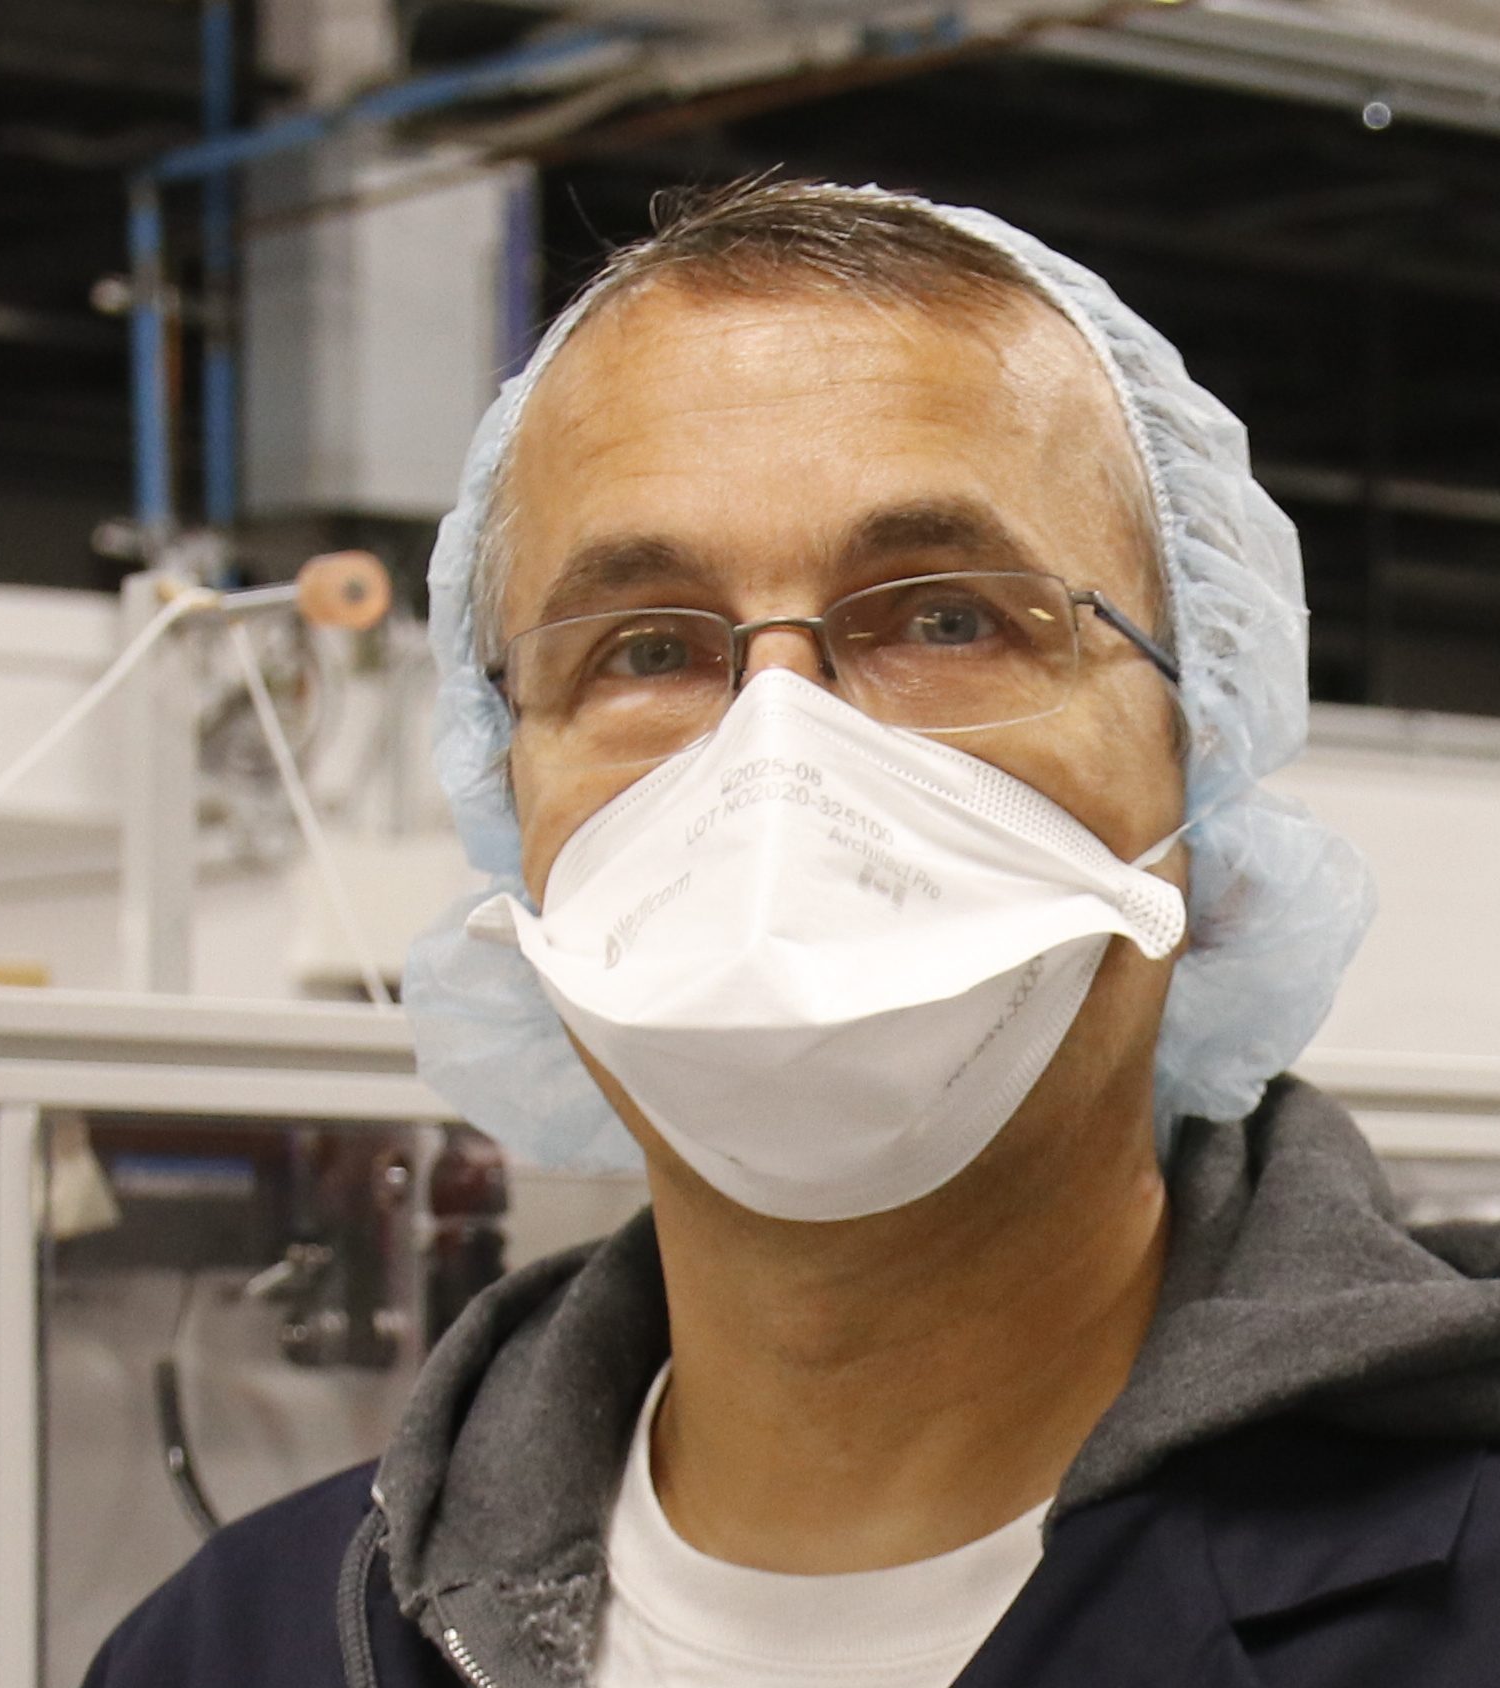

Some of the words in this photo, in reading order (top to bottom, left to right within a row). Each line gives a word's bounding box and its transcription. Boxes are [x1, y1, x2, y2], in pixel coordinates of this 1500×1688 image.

[685, 806, 719, 846] LOT
[827, 825, 912, 880] Architect
[912, 869, 942, 901] Pro
